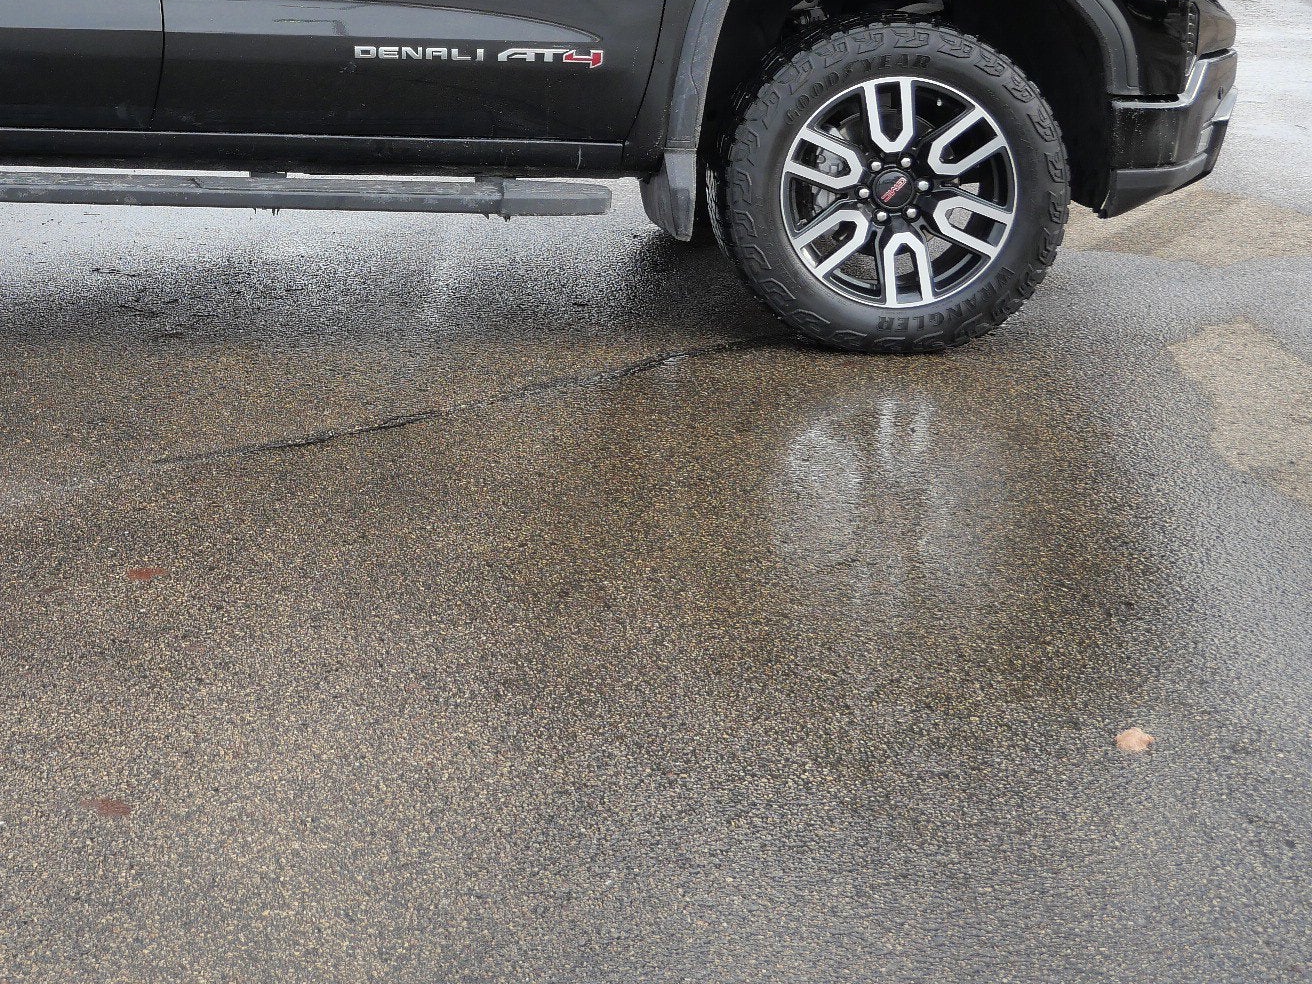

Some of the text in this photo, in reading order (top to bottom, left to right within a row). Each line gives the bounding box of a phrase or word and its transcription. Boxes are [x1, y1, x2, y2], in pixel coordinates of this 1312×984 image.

[354, 45, 604, 69] DENALI AT4
[783, 52, 931, 125] GOODYEAR
[880, 176, 907, 203] GMC
[877, 266, 1015, 332] WRANGLER
